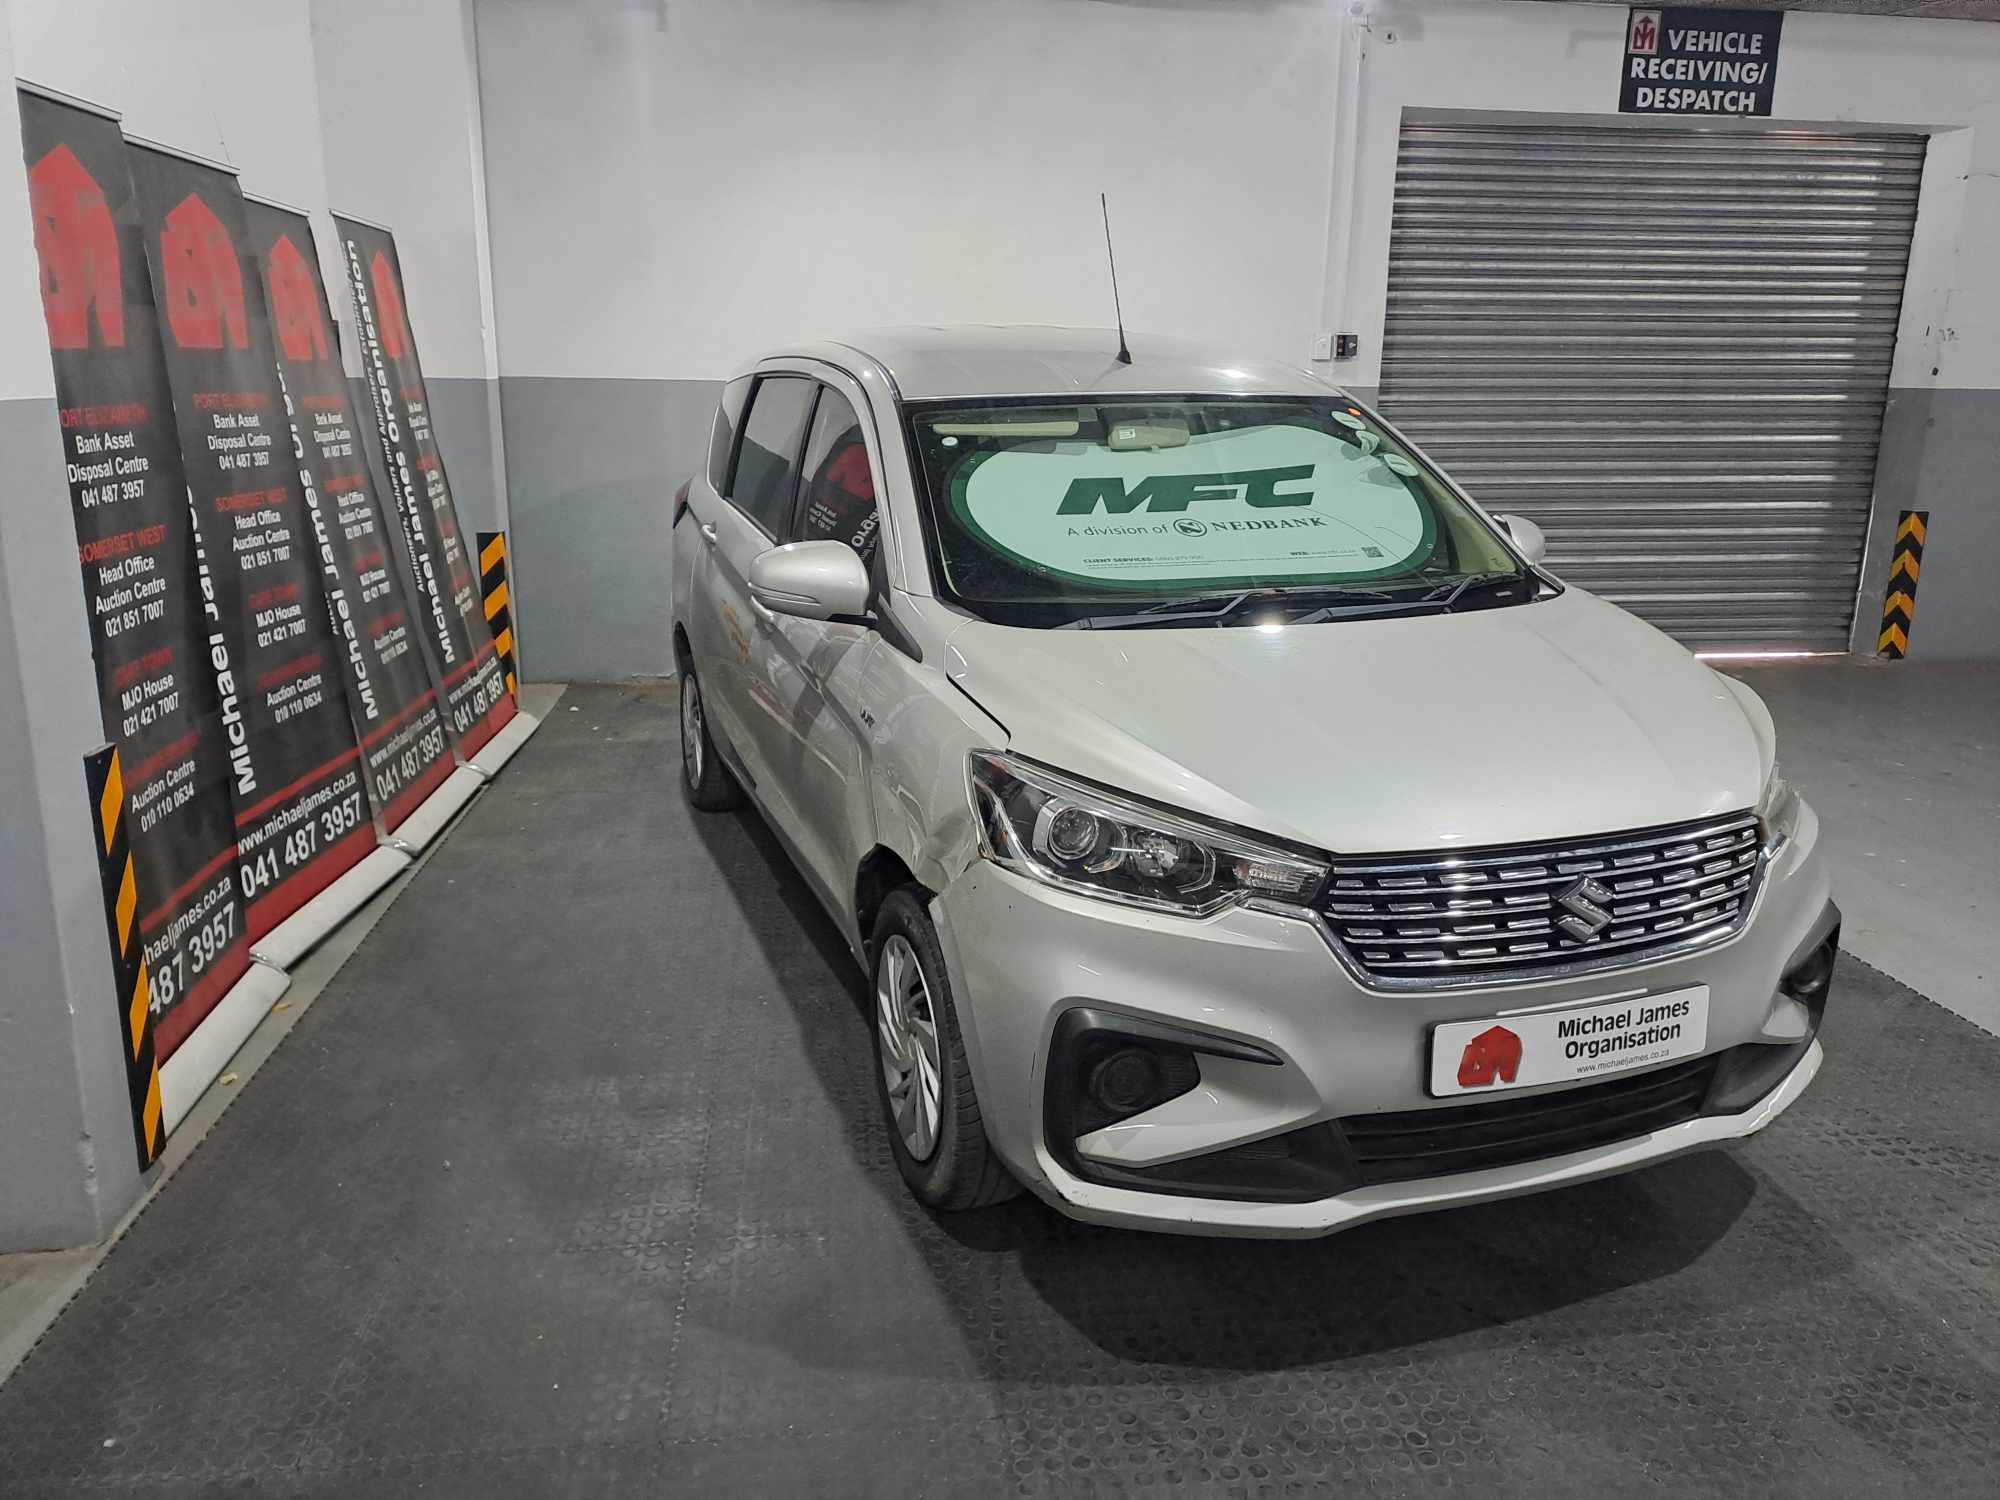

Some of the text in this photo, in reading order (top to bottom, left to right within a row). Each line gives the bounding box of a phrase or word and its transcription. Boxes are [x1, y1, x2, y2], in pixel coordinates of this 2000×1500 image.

[1668, 29, 1763, 54] VEHICLE
[1630, 57, 1768, 85] RECEIVING/
[1636, 87, 1756, 112] DESPATCH
[347, 239, 399, 443] Organisation
[213, 413, 260, 429] Bank Asset
[76, 431, 134, 454] Bank Asset
[207, 434, 247, 452] Disposal
[67, 456, 149, 484] Disposal Centre
[219, 455, 235, 470] 041
[236, 453, 251, 468] 487
[81, 479, 144, 508] 041 487 3957
[395, 451, 426, 546] James
[1056, 463, 1315, 516] MFC
[234, 510, 281, 530] Head Office
[300, 469, 339, 580] James
[1068, 516, 1327, 537] A division of NEDBANK
[233, 528, 290, 552] Auction Centre
[99, 556, 155, 586] Head Office
[240, 553, 256, 570] 021
[256, 550, 272, 566] 851
[96, 578, 166, 615] Auction Centre
[418, 552, 455, 663] Michael
[105, 599, 164, 638] 021 851 7007
[256, 604, 301, 628] MJO House
[257, 631, 273, 648] 021
[273, 625, 288, 641] 421
[331, 588, 379, 719] Michael
[121, 674, 174, 711] MJO House
[266, 673, 322, 707] Auction Centre
[123, 692, 179, 737] 021 421 7007
[209, 633, 256, 796] Michael
[275, 707, 288, 723] 010
[289, 698, 303, 716] 110
[454, 701, 474, 732] 041
[376, 725, 444, 801] 041 487 3957
[131, 760, 196, 814] Auction Centre
[141, 781, 194, 833] 010 110 0634
[238, 771, 356, 856] www.michaeljames.co.za
[240, 791, 361, 898] 041 487 3957
[148, 901, 235, 1015] 487 3957
[1558, 1000, 1690, 1039] Michael James
[1565, 1023, 1681, 1060] Organisation
[1576, 1047, 1670, 1074] www.michaeljames.co.za
